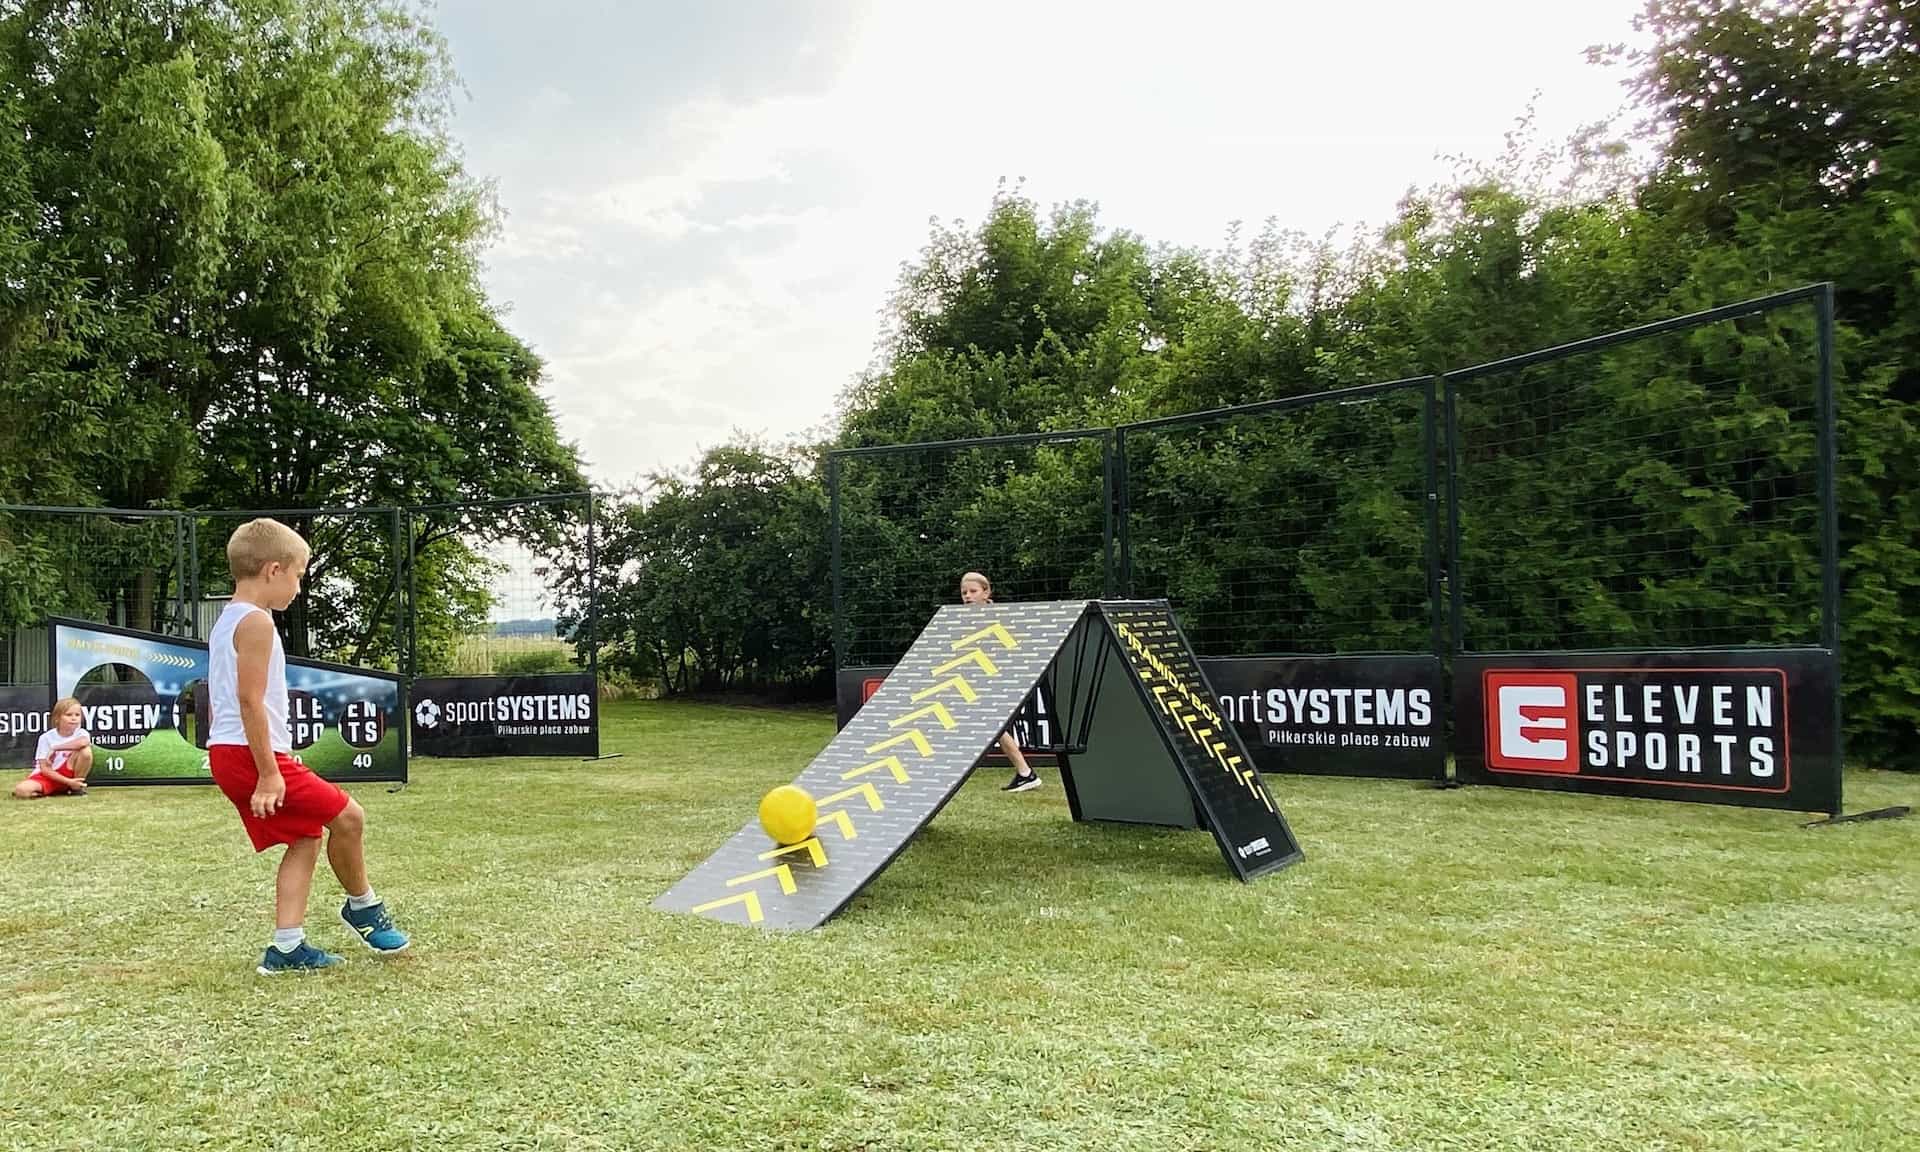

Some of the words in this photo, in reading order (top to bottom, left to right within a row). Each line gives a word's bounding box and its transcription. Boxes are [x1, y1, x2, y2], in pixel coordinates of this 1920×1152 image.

[1118, 623, 1189, 700] PIRAMIDA
[1191, 693, 1223, 731] BOX
[446, 694, 591, 725] sportSYSTEMS
[1219, 688, 1431, 726] ortSYSTEMS
[1586, 685, 1772, 727] ELEVEN
[540, 724, 562, 735] place
[564, 725, 590, 734] zabaw
[1269, 730, 1336, 745] Piłkarskie
[1341, 732, 1379, 746] place
[1384, 734, 1430, 747] zabaw
[106, 757, 124, 770] 10
[353, 753, 373, 768] 40
[1588, 730, 1774, 777] SPORTS
